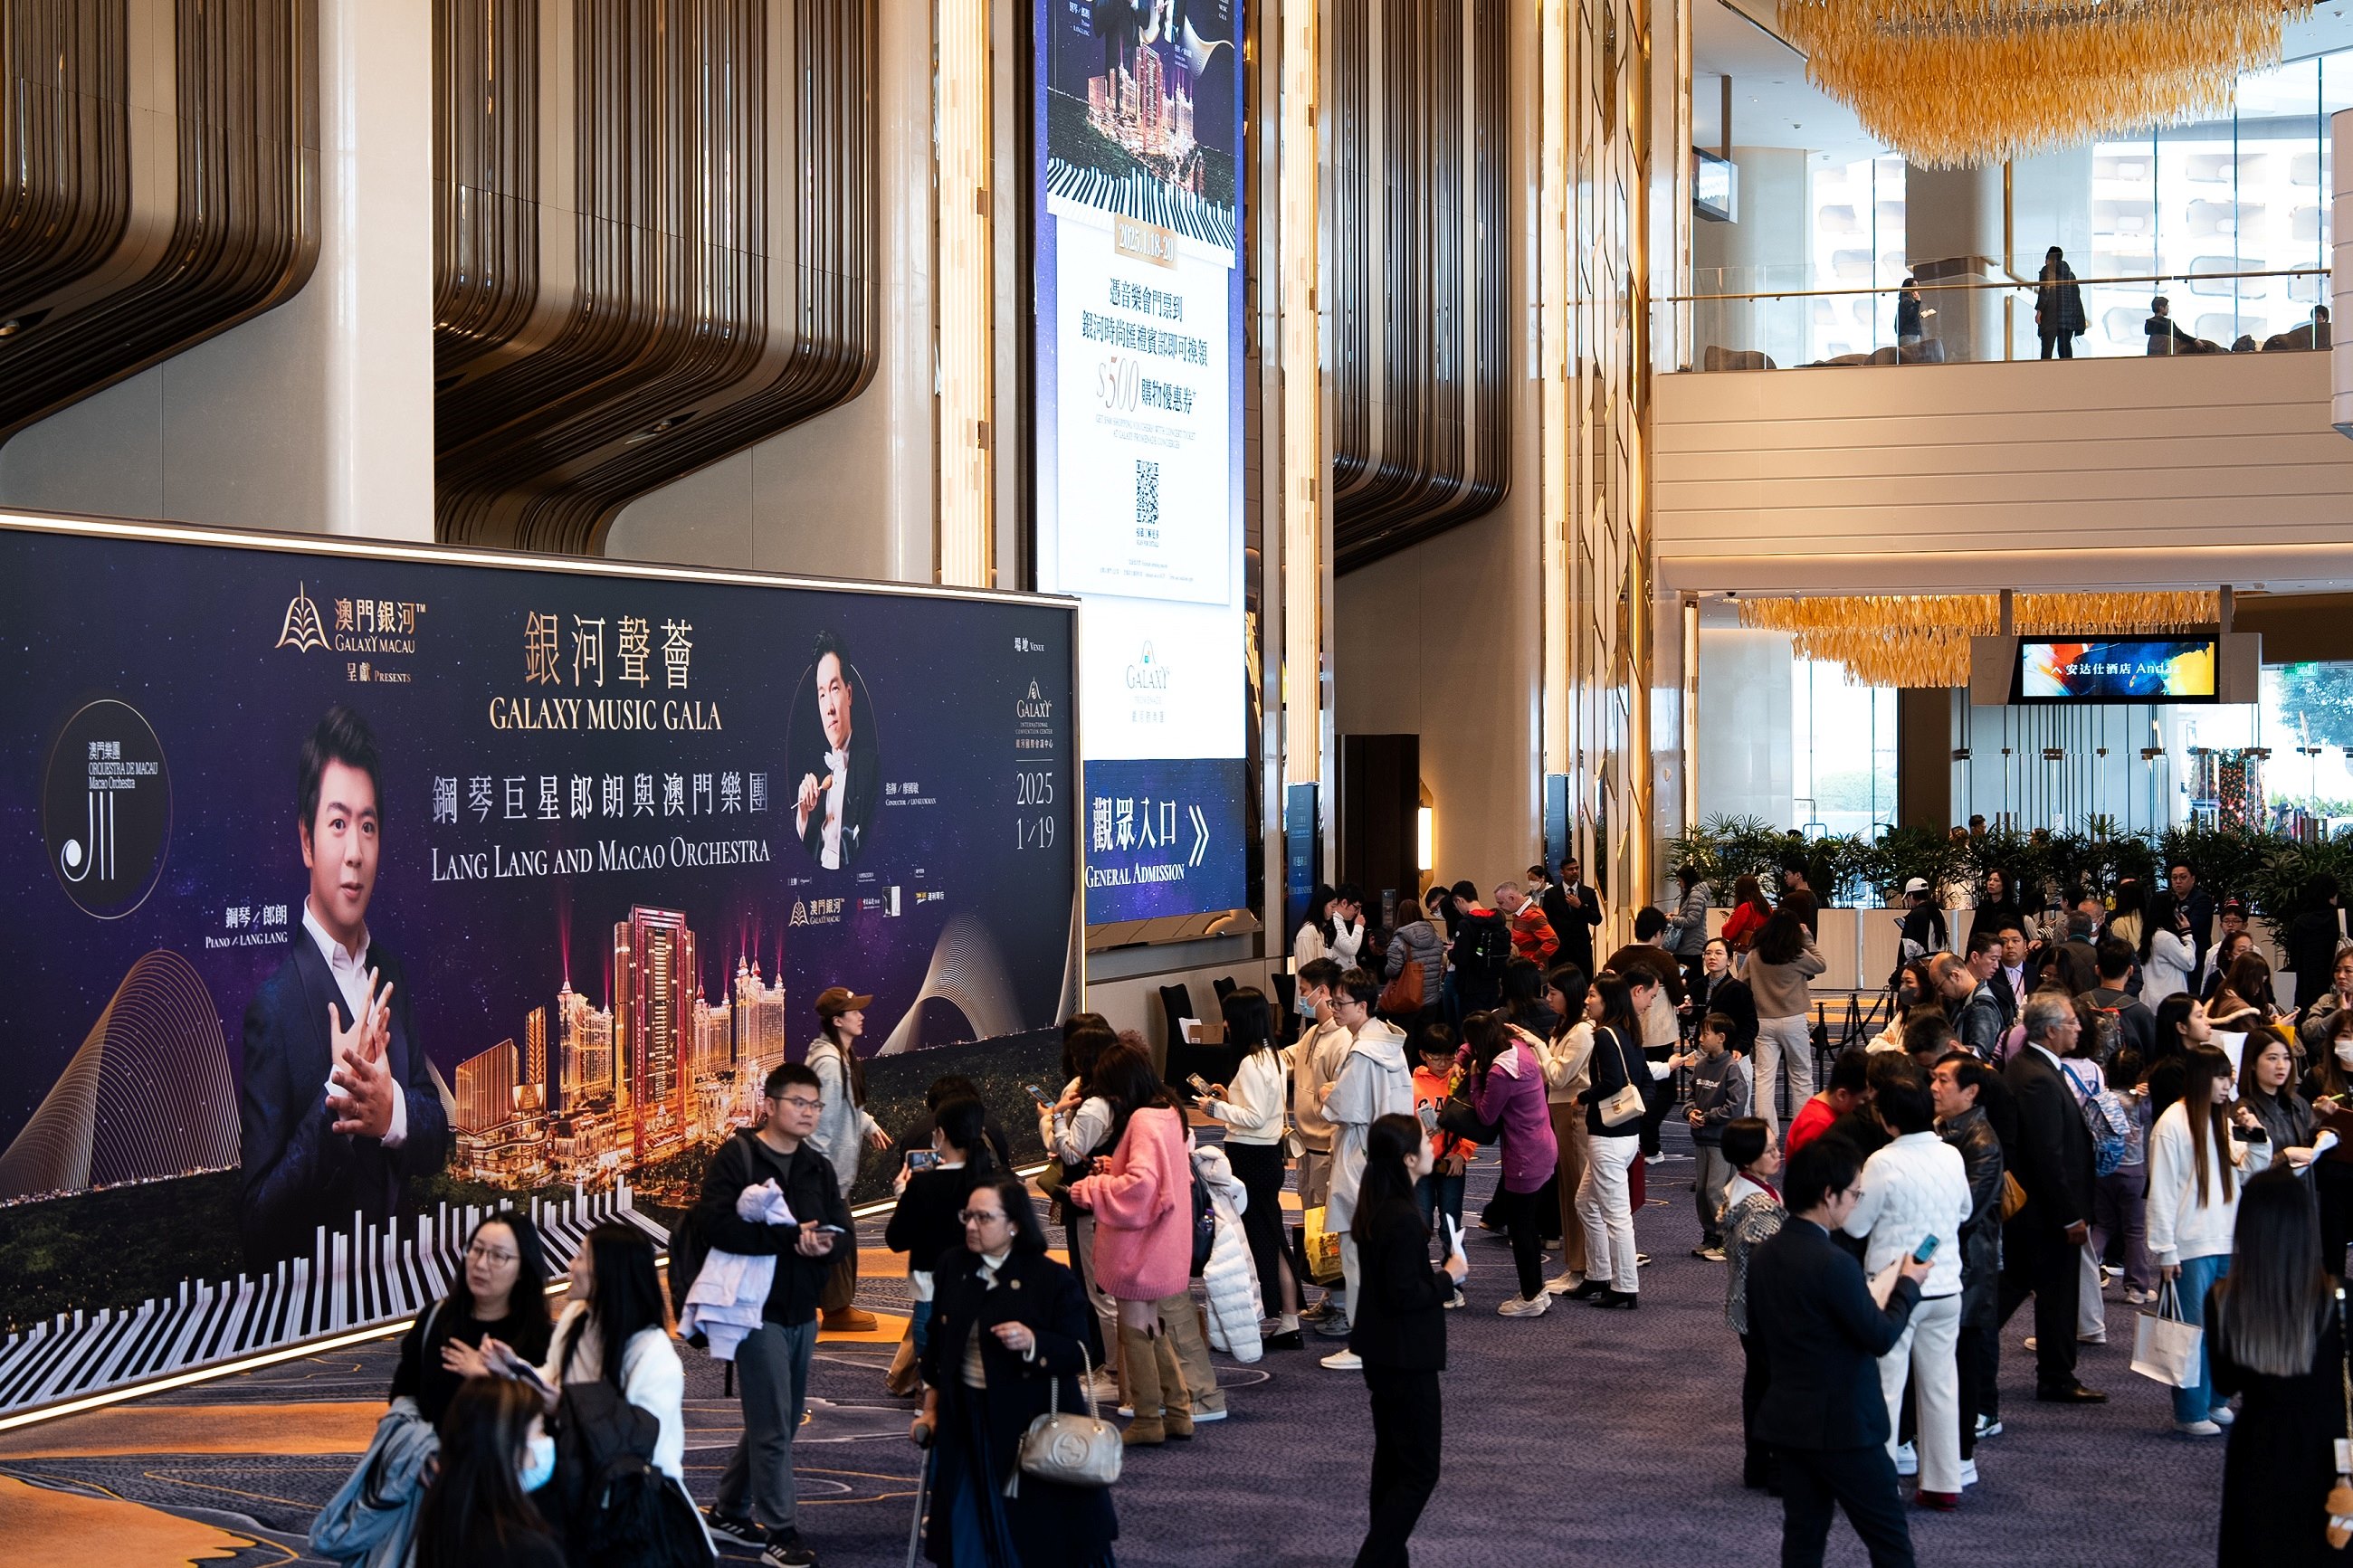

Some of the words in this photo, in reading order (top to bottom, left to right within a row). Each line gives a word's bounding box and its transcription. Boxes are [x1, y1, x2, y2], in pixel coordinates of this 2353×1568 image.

[524, 610, 693, 689] 銀河聲薈
[2065, 662, 2131, 675] 安达仕酒店
[2136, 662, 2180, 674] Andaz
[489, 697, 582, 730] GALAXY
[586, 698, 657, 730] MUSIC
[662, 699, 722, 731] GALA
[126, 762, 135, 775] DE
[135, 762, 158, 775] MACAU
[432, 770, 768, 825] 鋼琴巨星郎朗與澳門樂團
[1016, 772, 1053, 805] 2025
[1092, 796, 1176, 853] 觀眾入口
[431, 847, 488, 882] LANG
[493, 844, 548, 878] LANG
[553, 849, 593, 875] AND
[597, 840, 665, 871] MACAO
[670, 835, 770, 869] ORCHESTRA
[1085, 864, 1131, 889] GENERAL
[1132, 860, 1185, 884] ADMISSION
[240, 934, 263, 946] LANG
[264, 931, 288, 945] LANG
